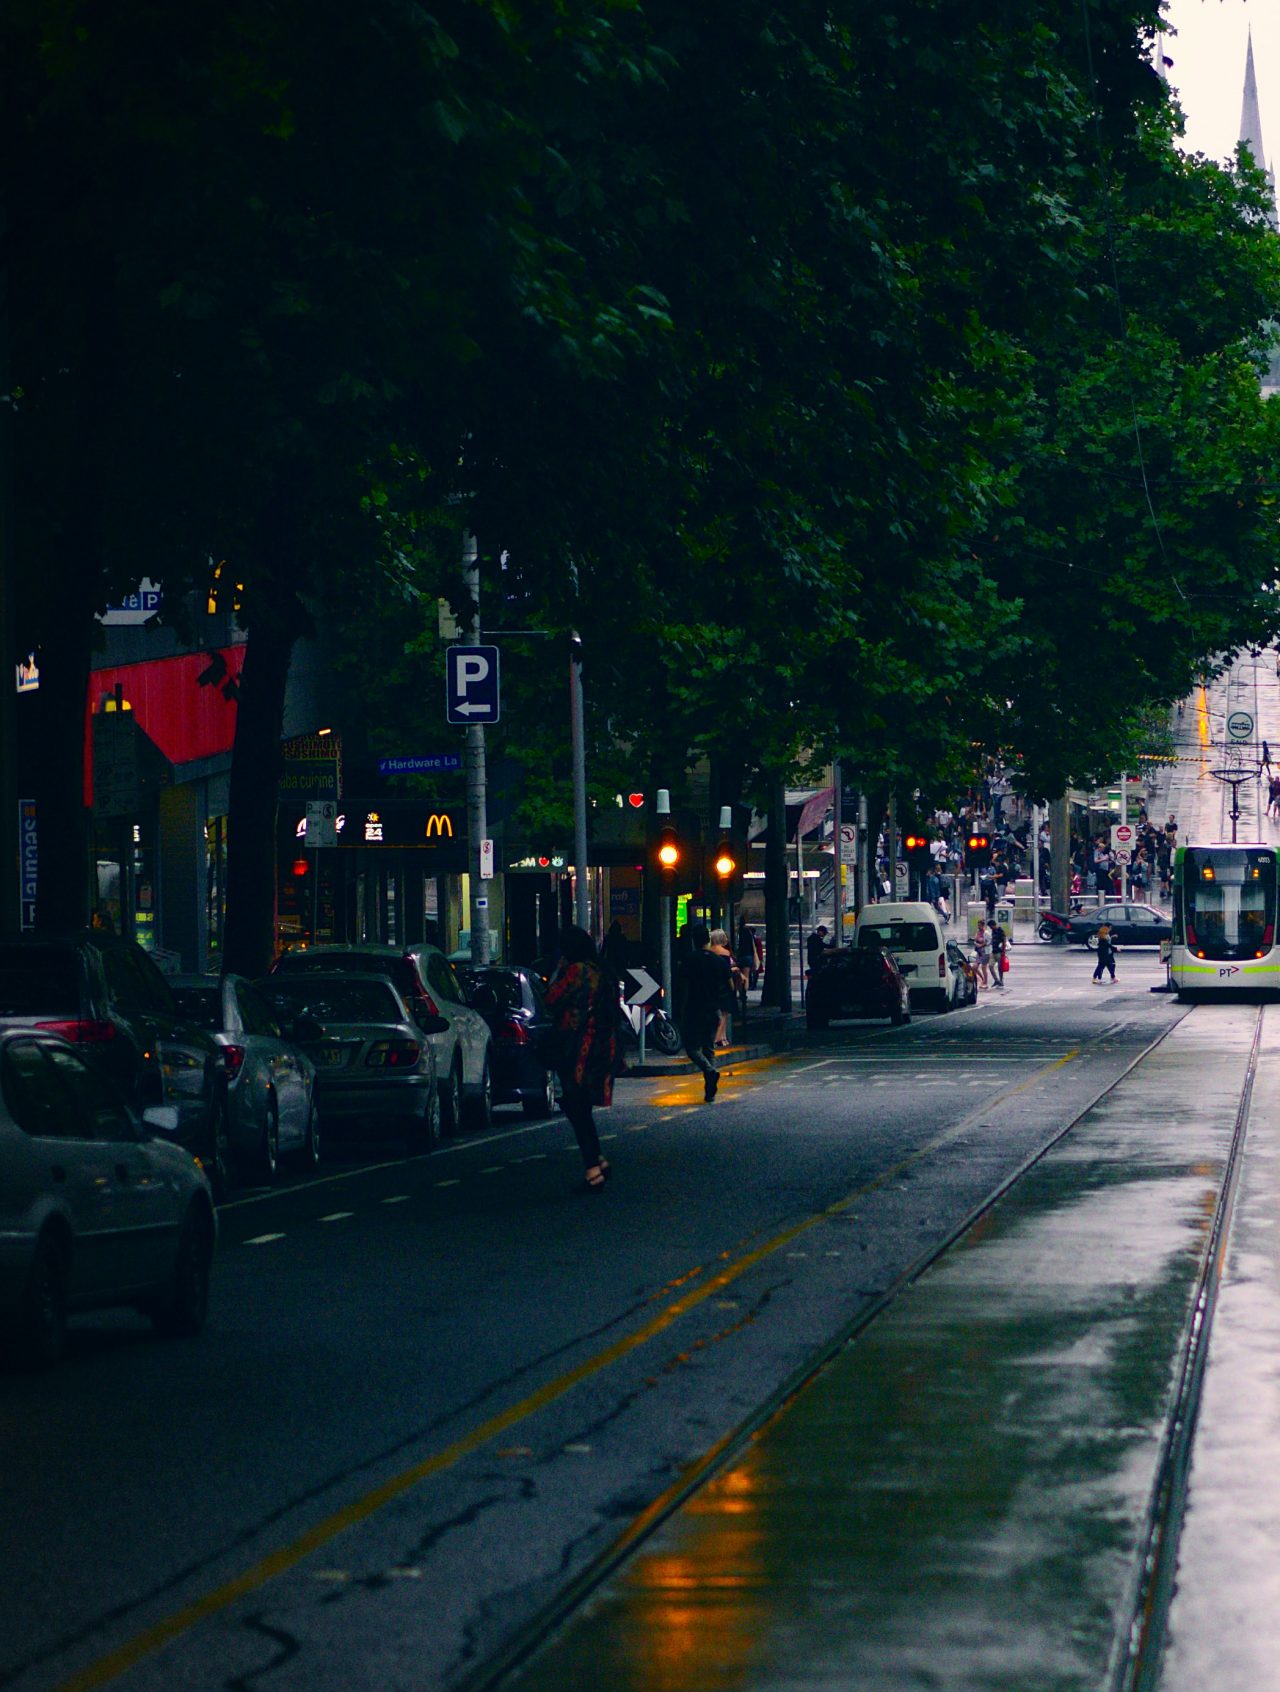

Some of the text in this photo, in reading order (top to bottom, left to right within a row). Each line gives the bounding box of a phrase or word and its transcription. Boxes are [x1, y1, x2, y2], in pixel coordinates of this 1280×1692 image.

[457, 655, 489, 696] P
[388, 756, 457, 770] Hardware La
[365, 828, 383, 836] 24
